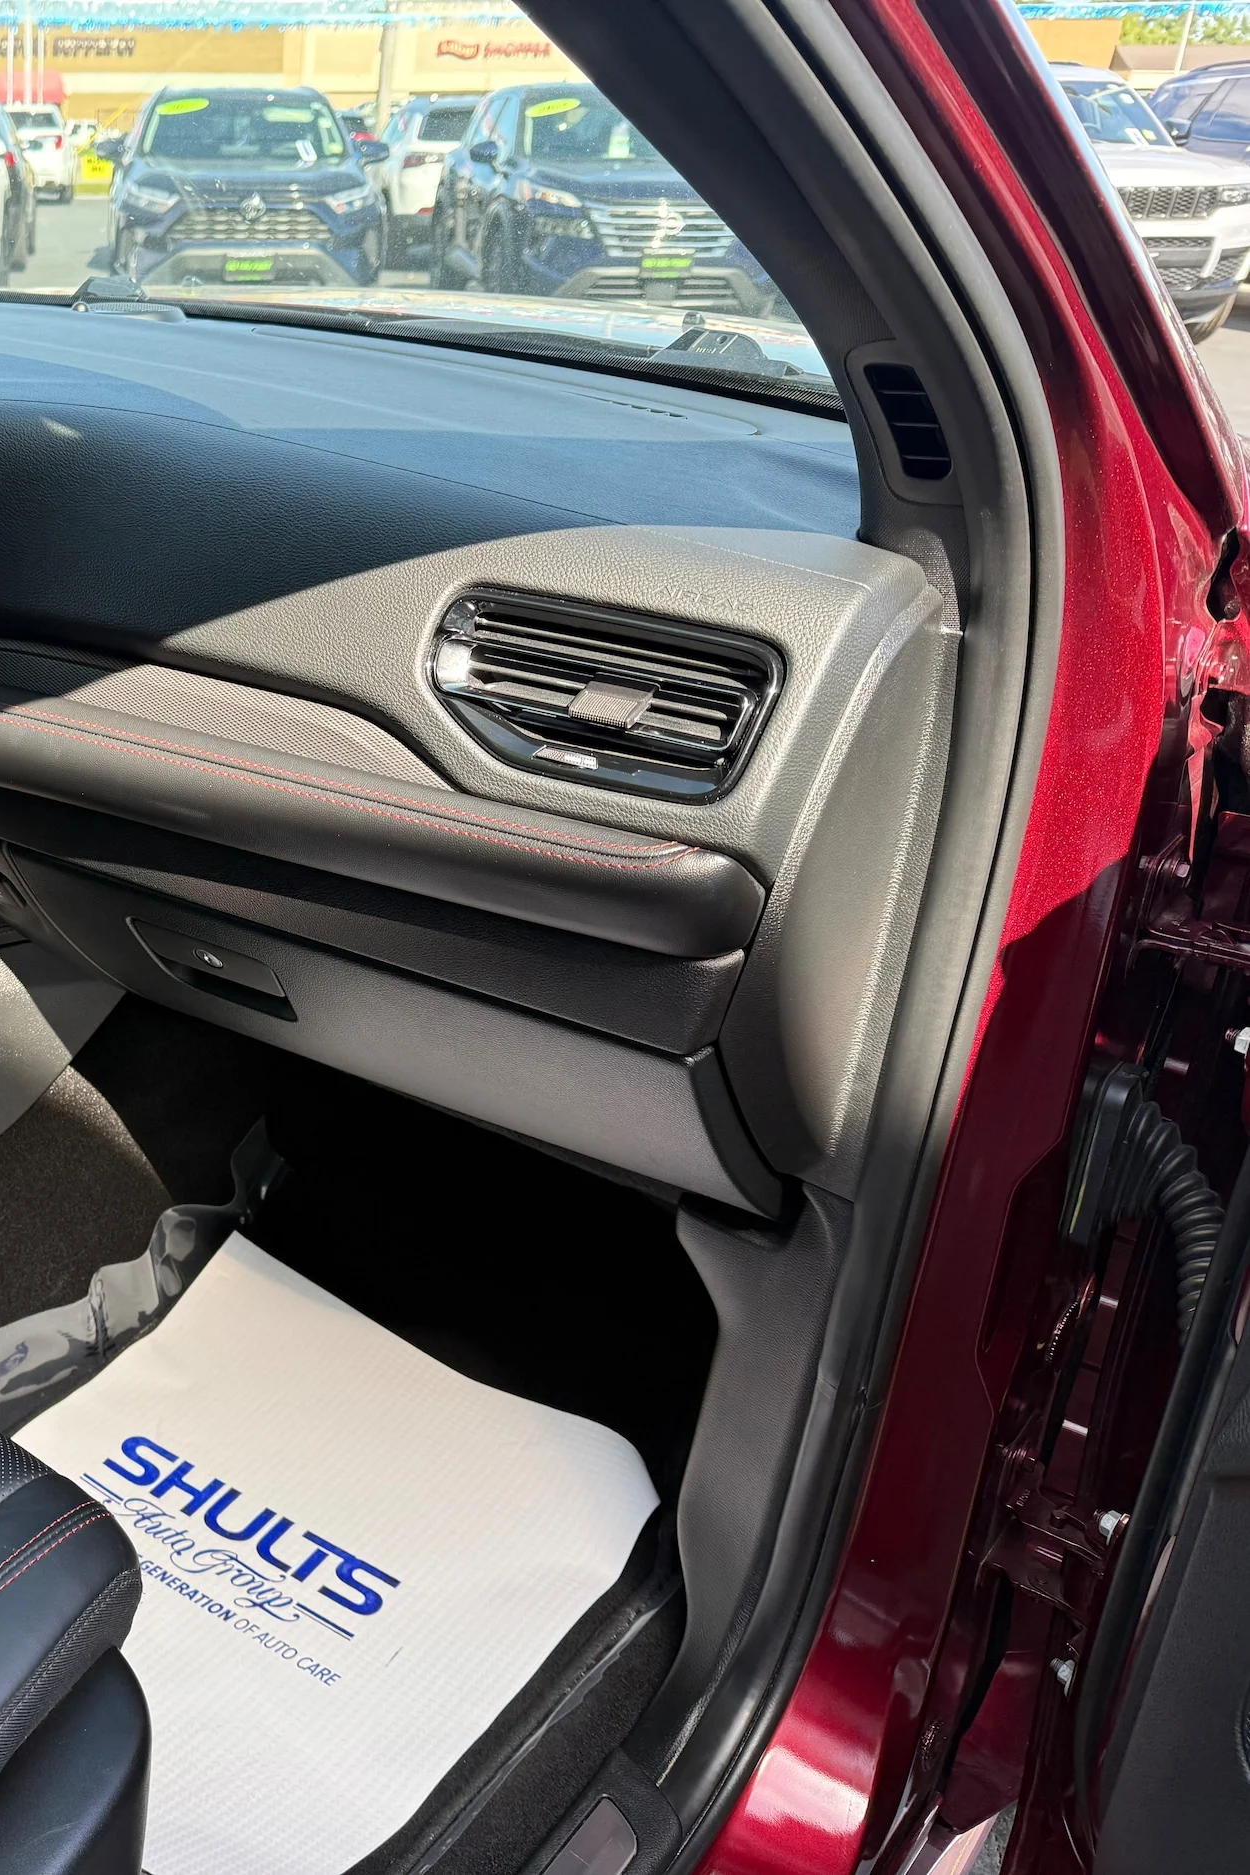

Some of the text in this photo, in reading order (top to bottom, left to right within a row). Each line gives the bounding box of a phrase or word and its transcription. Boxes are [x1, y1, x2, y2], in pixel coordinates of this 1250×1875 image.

[103, 1436, 402, 1616] SHULTS
[103, 1497, 300, 1622] Auto Group
[140, 1559, 342, 1687] GENERATION OF AUTO CARE
